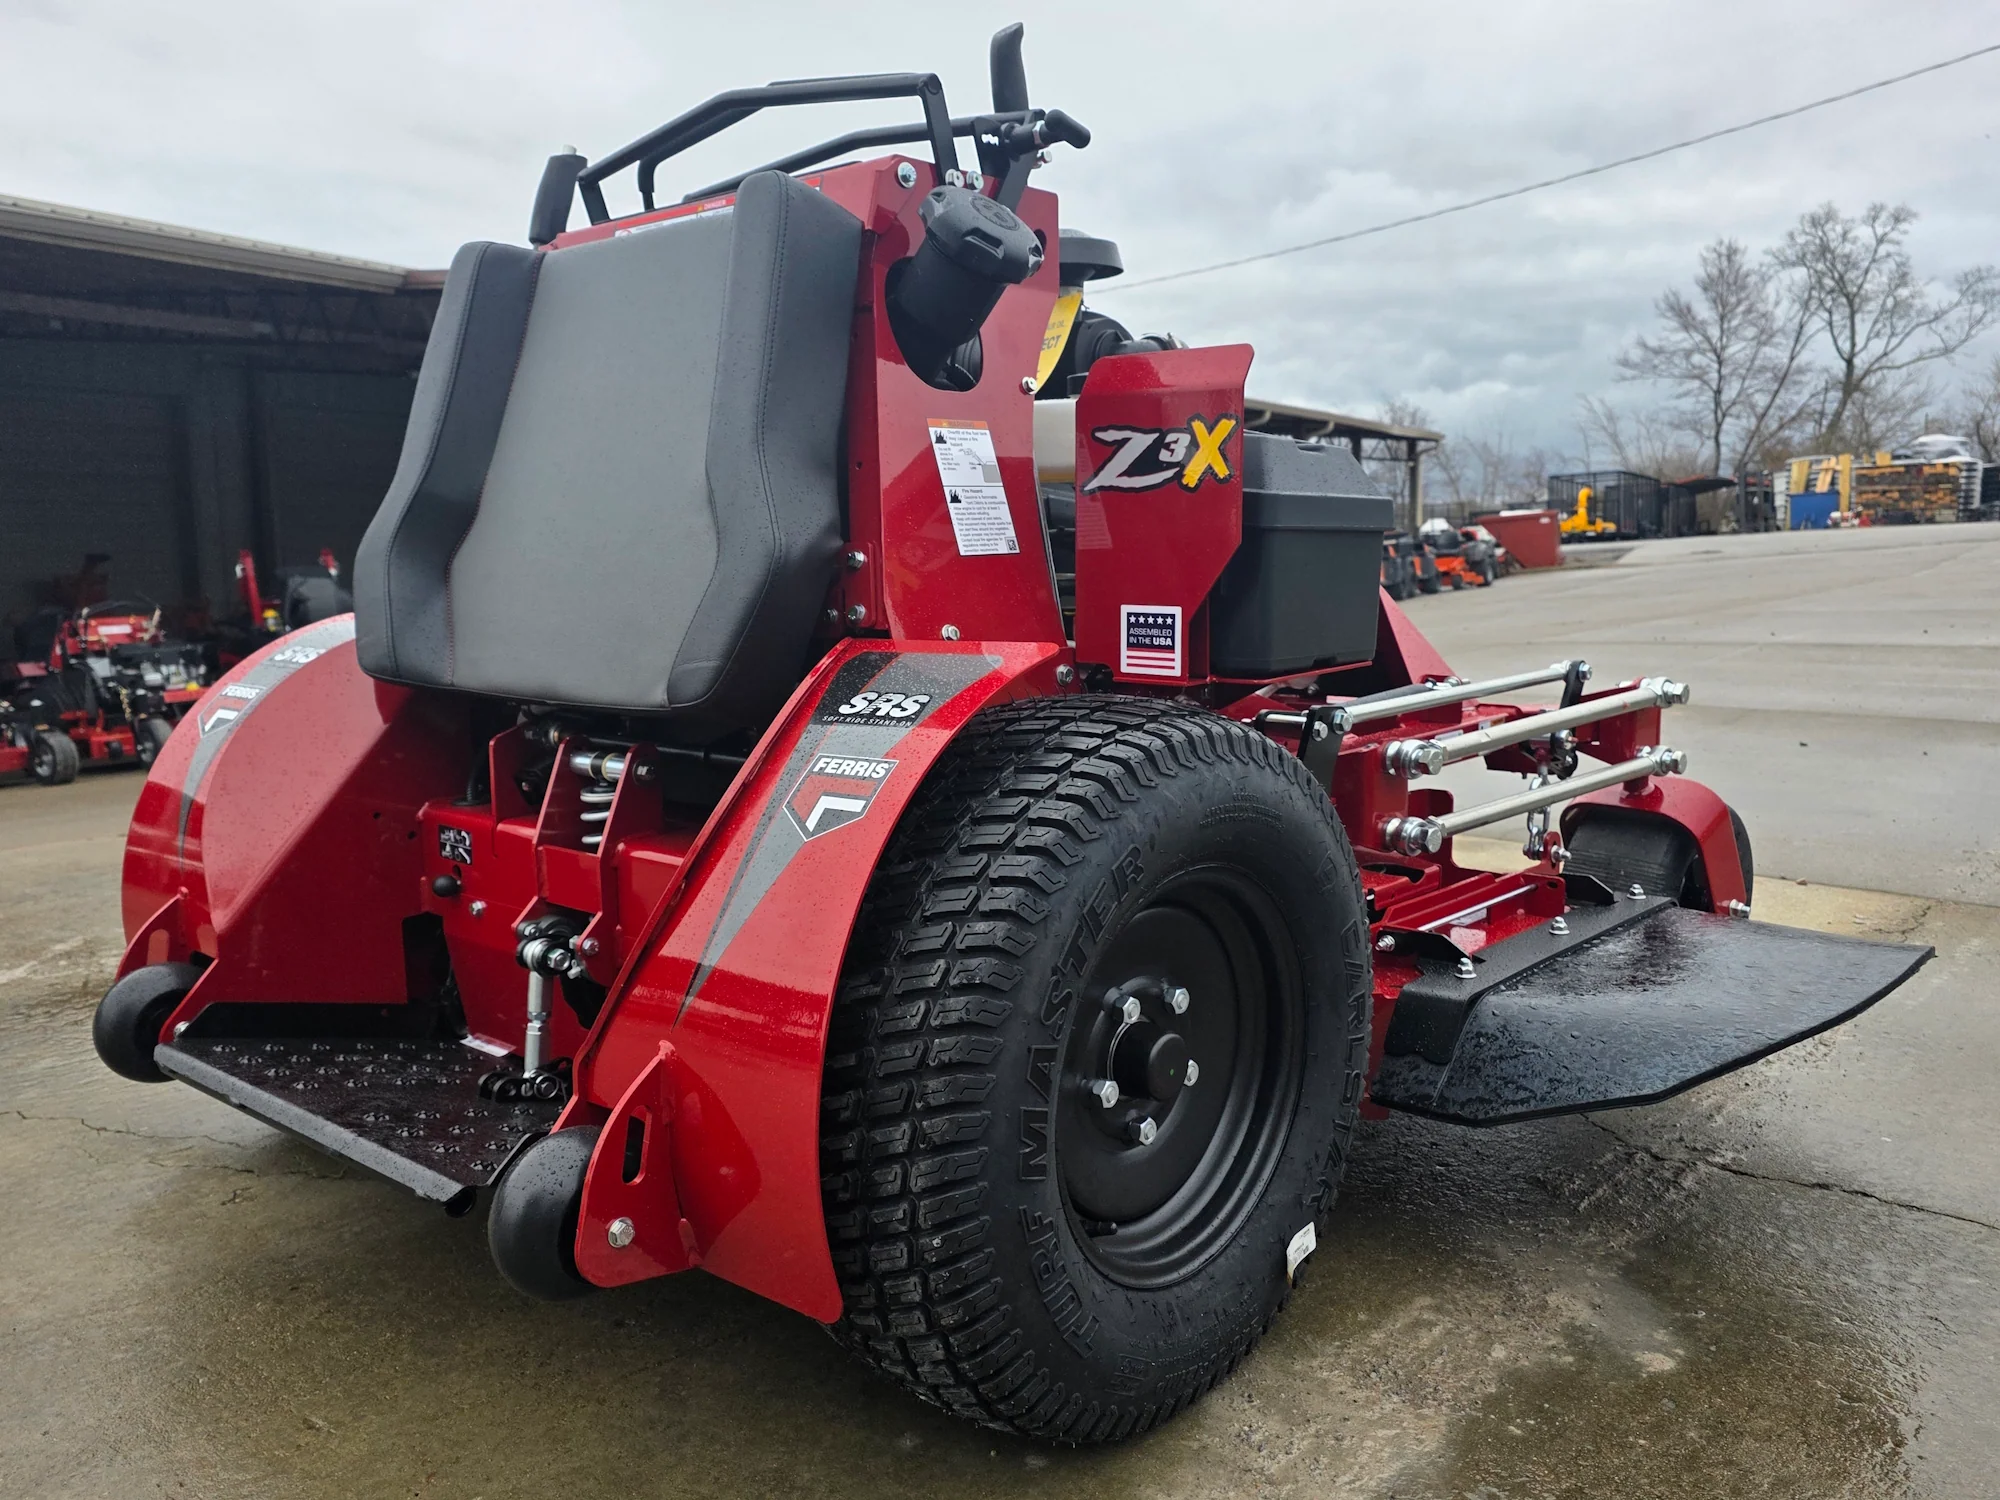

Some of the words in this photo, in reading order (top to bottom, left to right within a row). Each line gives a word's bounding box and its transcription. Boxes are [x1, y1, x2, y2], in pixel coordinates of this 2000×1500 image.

[1129, 627, 1173, 637] ASSEMBLED
[1129, 636, 1137, 644] IN
[1138, 636, 1152, 645] THE
[1153, 636, 1173, 646] USA
[838, 691, 931, 718] SRS
[868, 718, 913, 727] STAND-ON
[812, 757, 889, 779] FERRIS
[1018, 843, 1146, 1181] MASTER
[1019, 1205, 1101, 1359] TURF
